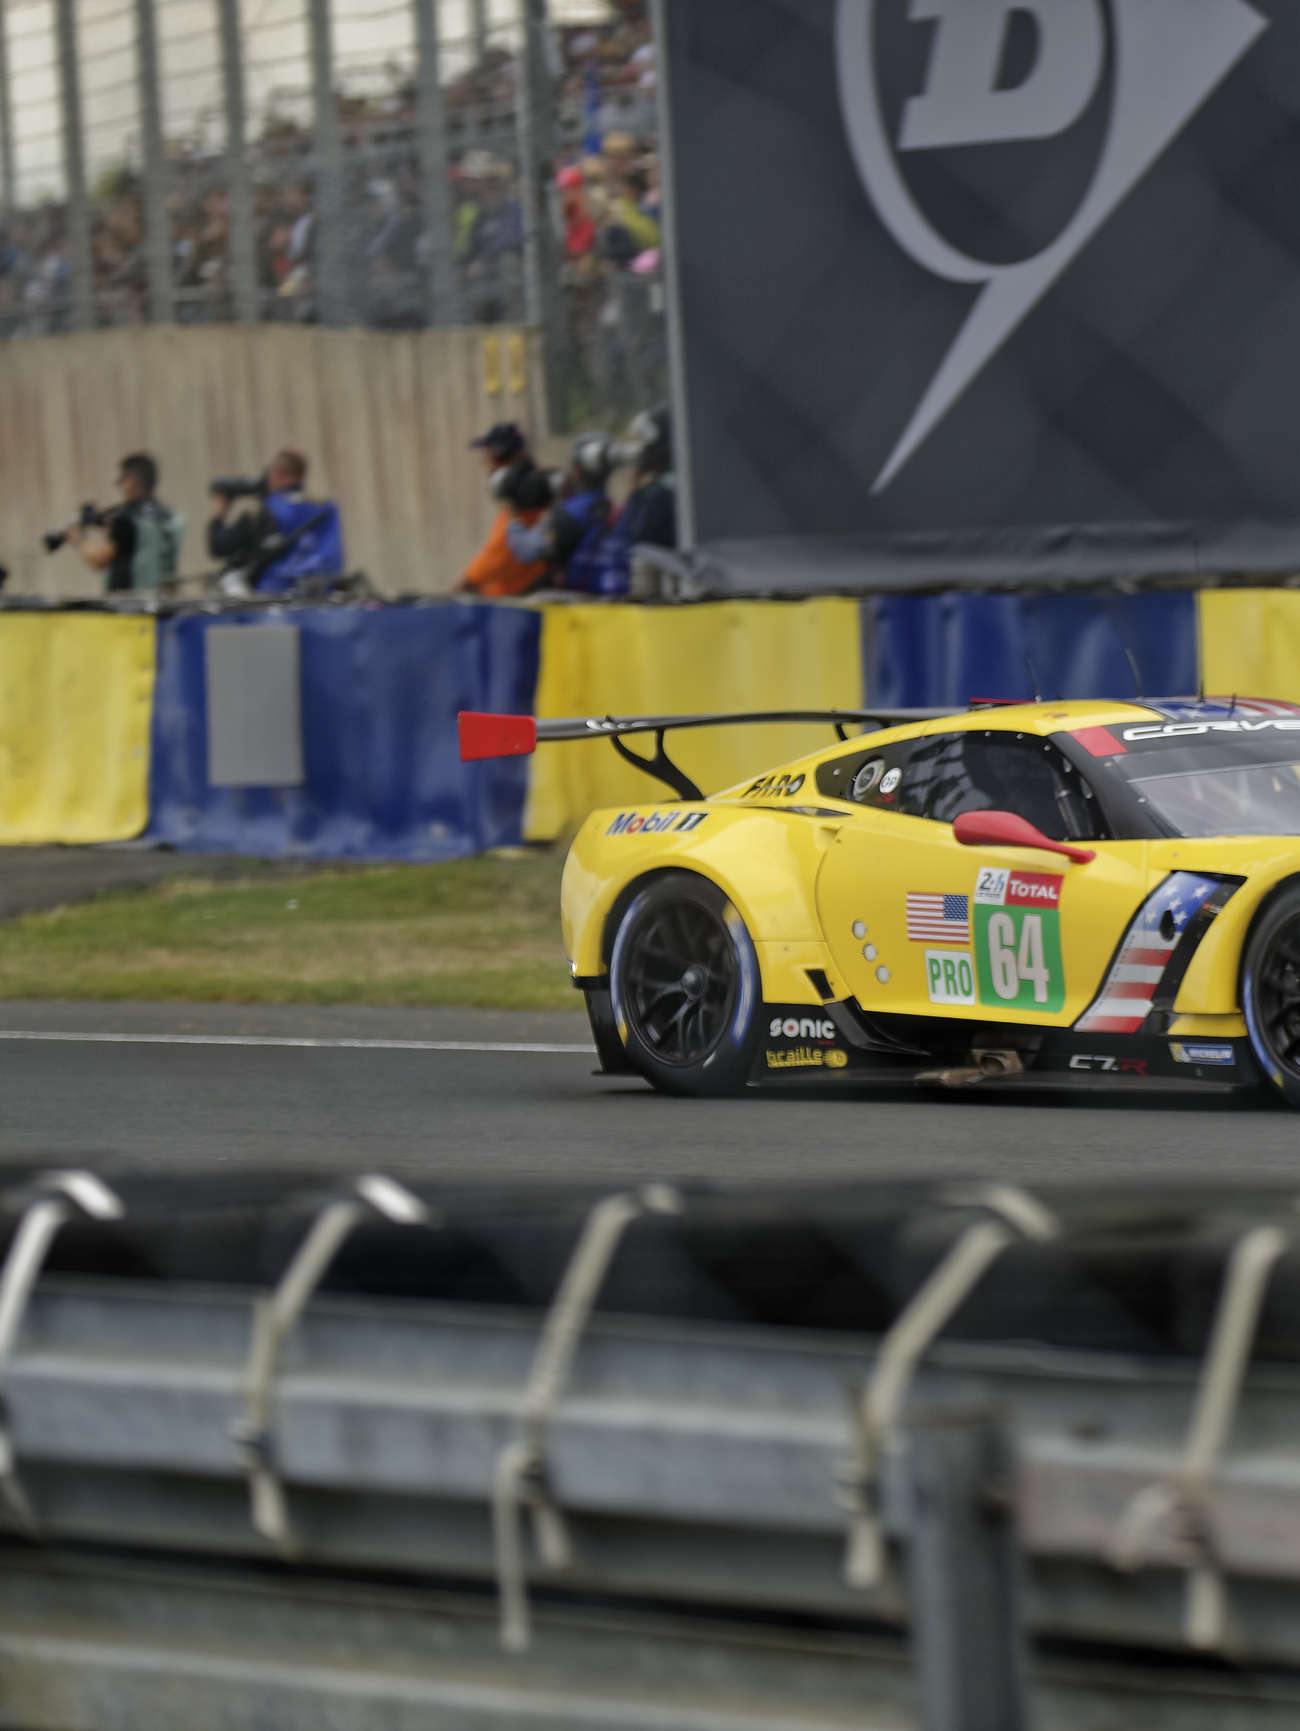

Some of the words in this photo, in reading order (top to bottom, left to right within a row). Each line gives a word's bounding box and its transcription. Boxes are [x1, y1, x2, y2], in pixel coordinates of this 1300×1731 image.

[897, 0, 1104, 150] D
[605, 811, 680, 836] Mobil
[927, 956, 974, 999] PRO
[987, 911, 1050, 1004] 64
